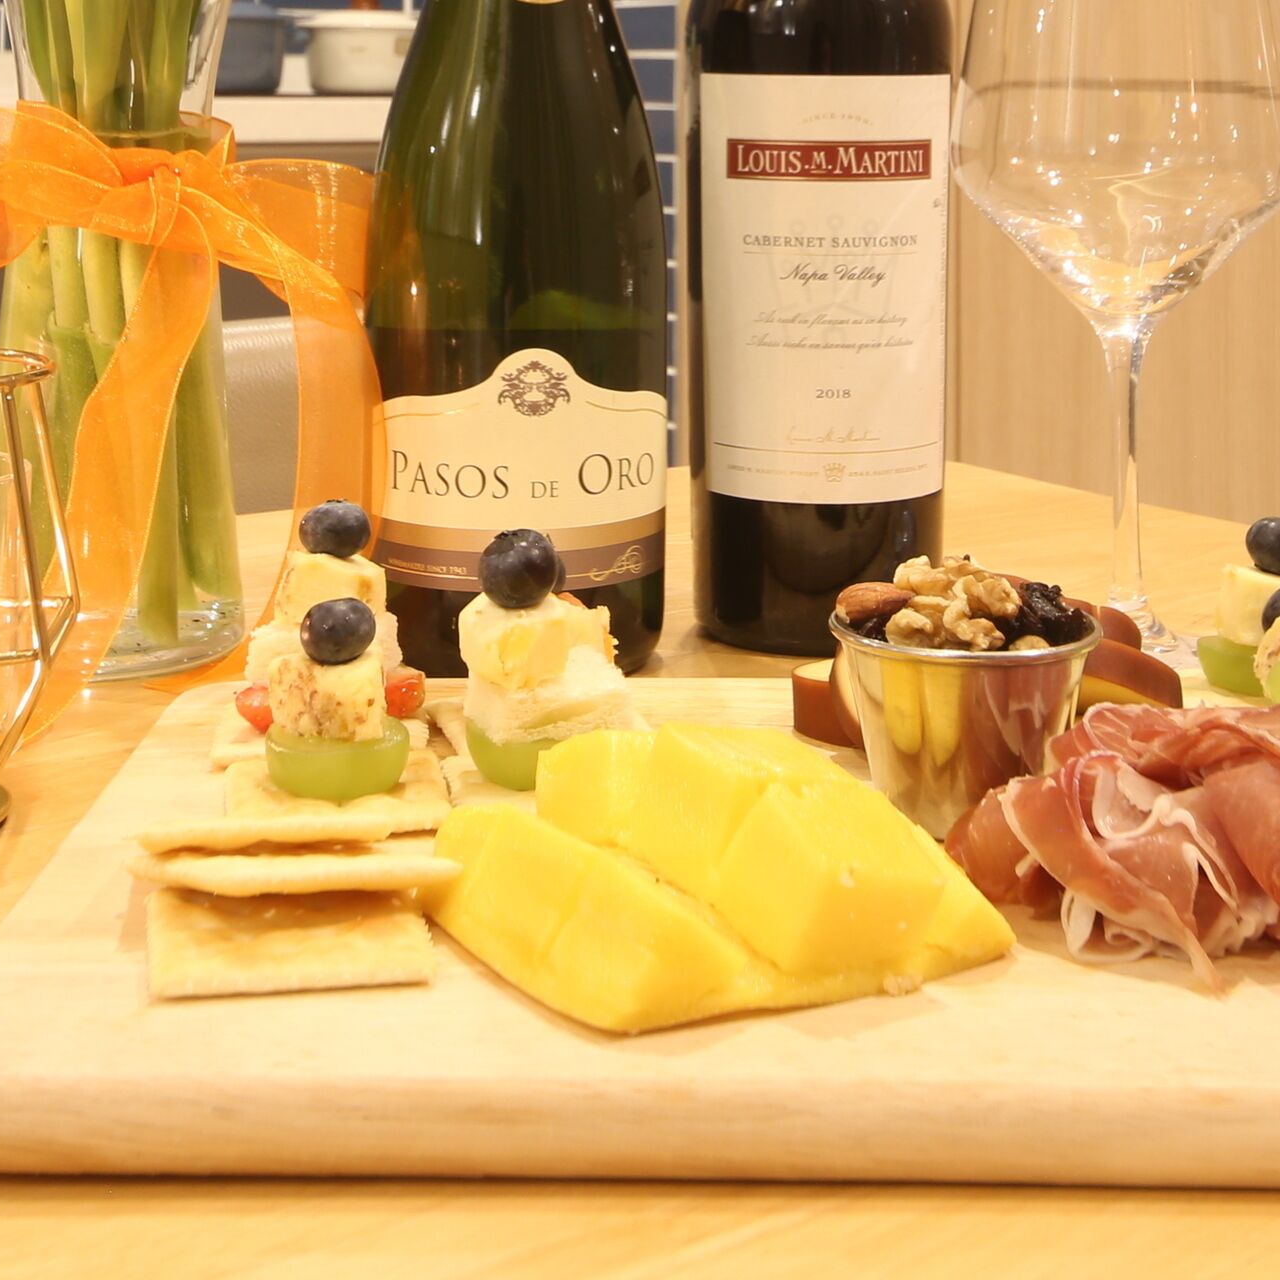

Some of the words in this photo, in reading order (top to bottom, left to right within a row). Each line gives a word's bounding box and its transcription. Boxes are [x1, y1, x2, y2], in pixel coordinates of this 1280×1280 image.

[737, 145, 802, 173] LOUIS
[833, 146, 924, 176] MARTINI
[743, 233, 826, 249] CABERNET
[831, 233, 918, 249] SAUVIGNON
[779, 263, 829, 287] Napa
[833, 263, 888, 288] Valley
[815, 388, 851, 399] 2018
[390, 449, 509, 499] PASOS
[530, 480, 559, 498] DE
[578, 452, 655, 495] ORO
